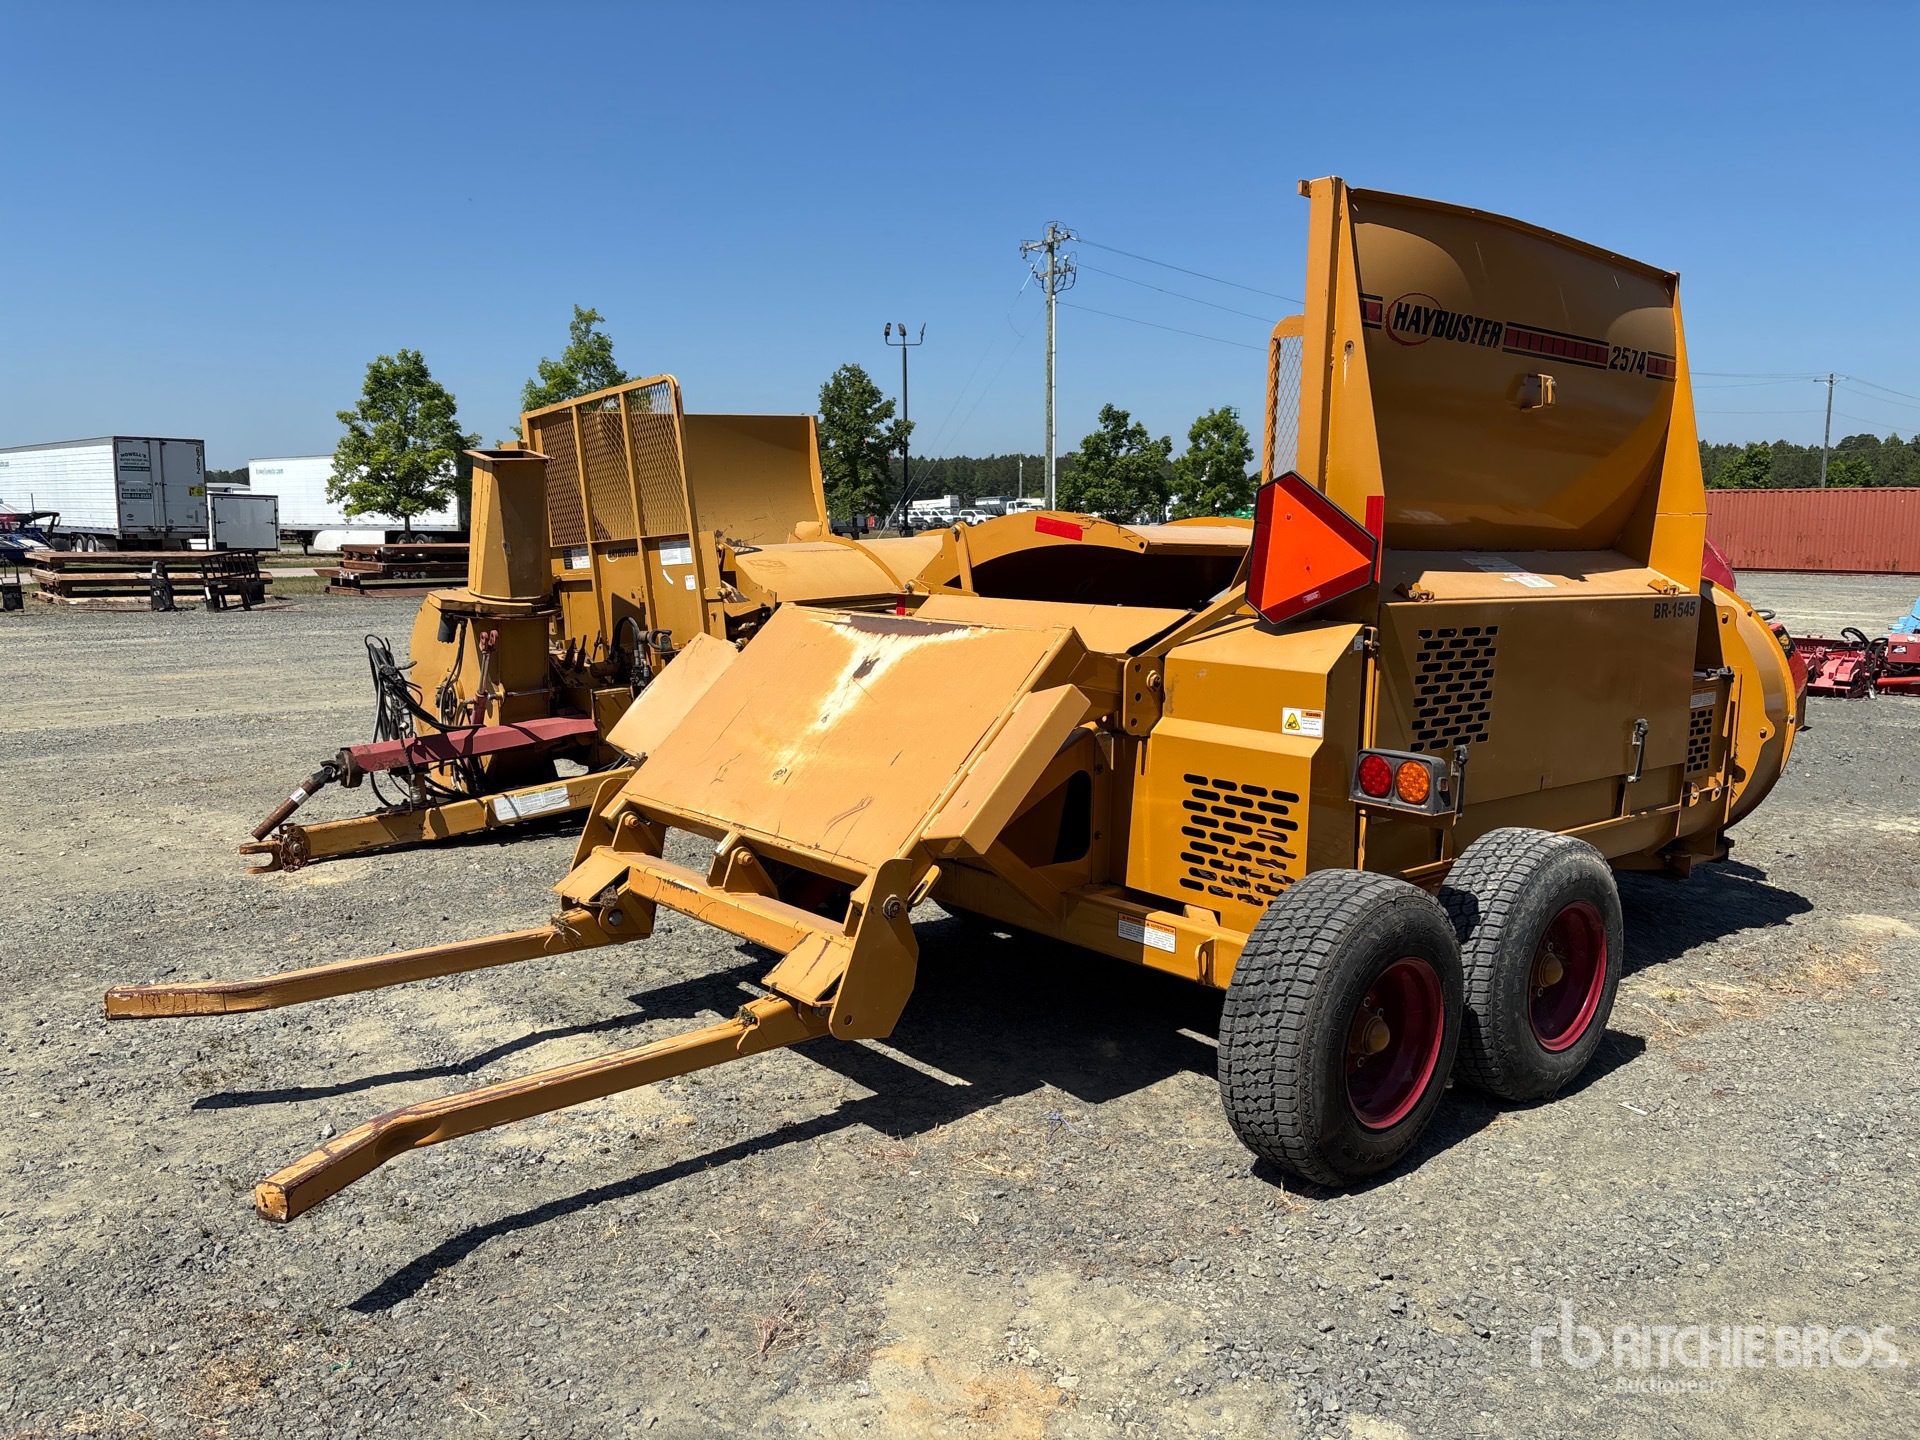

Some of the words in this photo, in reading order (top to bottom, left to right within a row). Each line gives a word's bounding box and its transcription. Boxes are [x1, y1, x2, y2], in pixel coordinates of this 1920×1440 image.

[1392, 301, 1503, 348] HAYBUSTER
[1609, 346, 1646, 375] 2574
[1653, 601, 1696, 619] BR-1545
